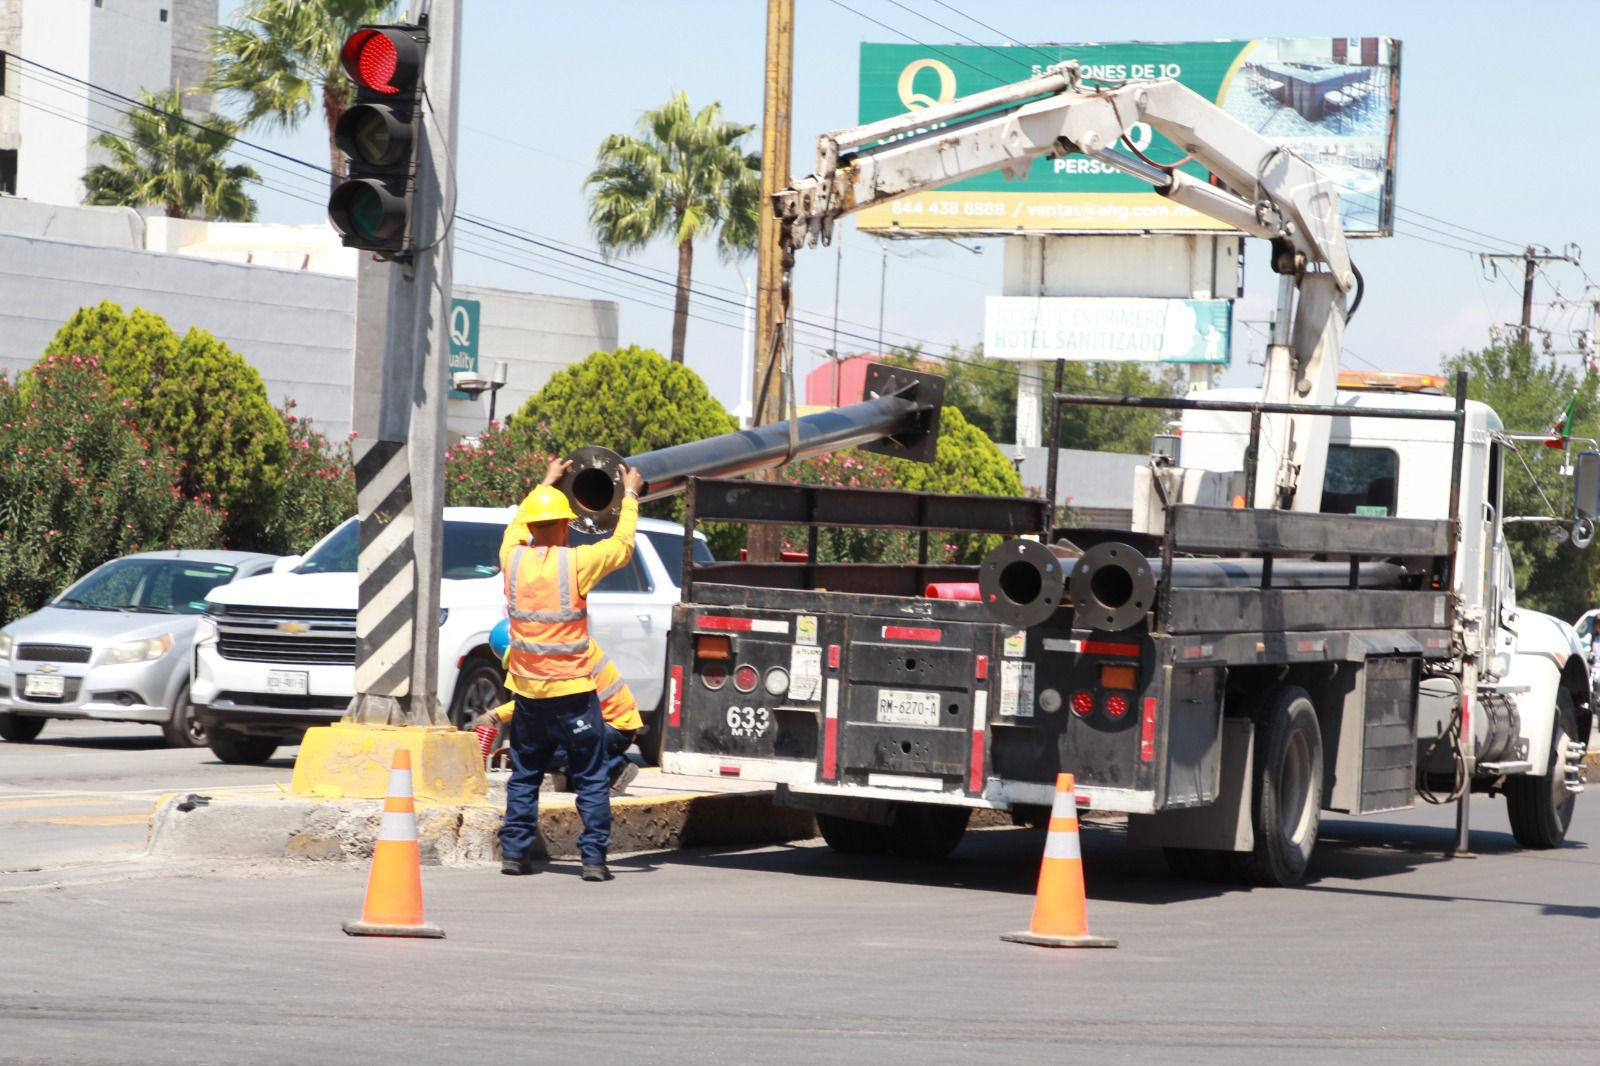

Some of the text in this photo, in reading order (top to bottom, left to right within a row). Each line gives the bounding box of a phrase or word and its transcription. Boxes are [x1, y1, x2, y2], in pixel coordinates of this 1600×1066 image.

[1131, 64, 1155, 78] DE
[1159, 63, 1182, 78] 10
[1053, 159, 1121, 174] PERSO
[891, 201, 923, 215] 844
[927, 201, 959, 216] 438
[963, 202, 1005, 216] 8888
[450, 306, 470, 347] Q
[1072, 309, 1091, 328] ES
[1095, 309, 1166, 329] PRIMERO
[994, 330, 1165, 352] HOTEL SANITIZADO
[449, 352, 475, 371] uality
[726, 705, 770, 730] 633
[731, 728, 765, 738] MTY
